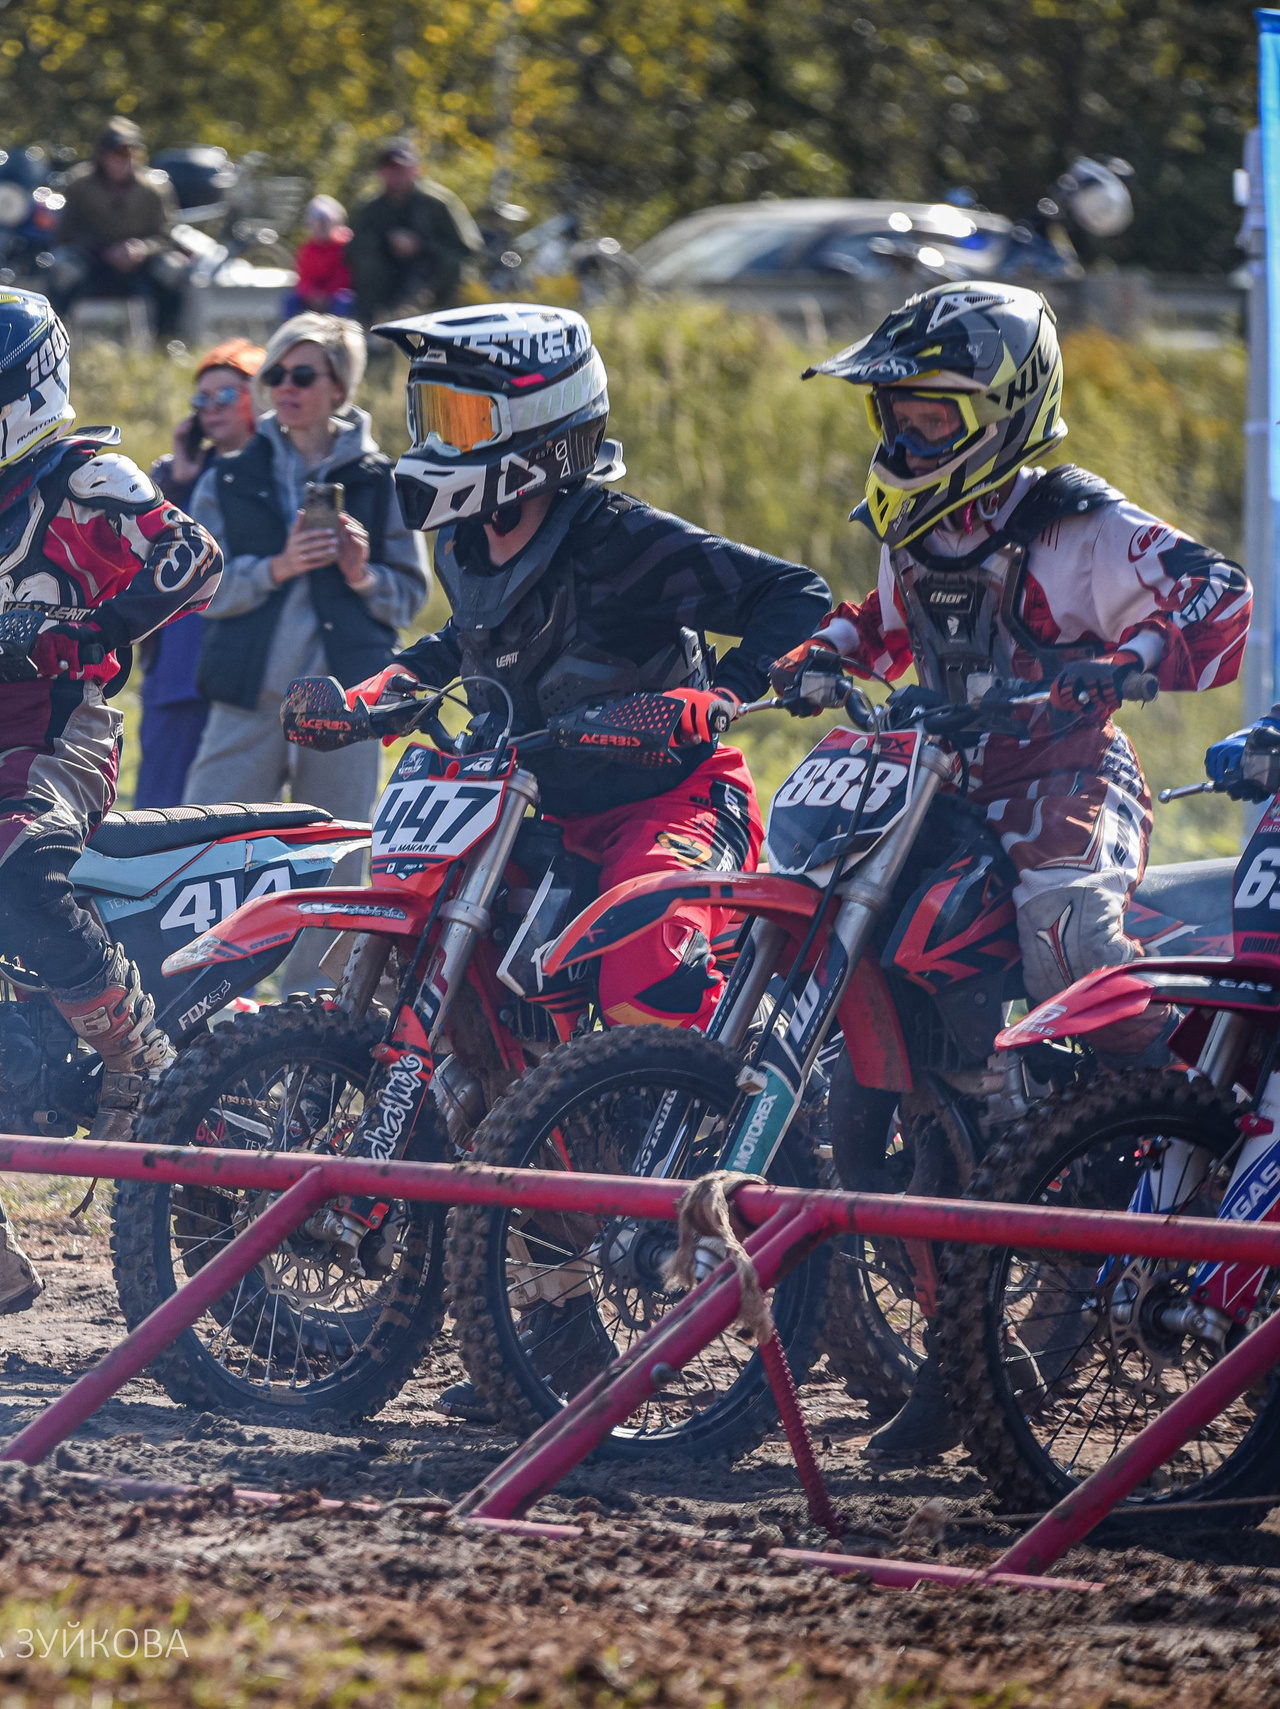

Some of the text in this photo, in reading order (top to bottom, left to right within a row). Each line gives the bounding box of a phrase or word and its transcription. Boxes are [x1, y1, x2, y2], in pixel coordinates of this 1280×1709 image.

[929, 590, 968, 604] thor
[48, 605, 92, 621] LEATT
[495, 651, 519, 668] LEATT
[299, 717, 352, 732] ACERBIS
[579, 732, 641, 748] ACERBIS
[774, 756, 909, 814] 888
[371, 784, 503, 845] 447
[159, 866, 292, 935] 414
[177, 994, 212, 1032] FOX
[732, 1091, 778, 1172] MOTOREX
